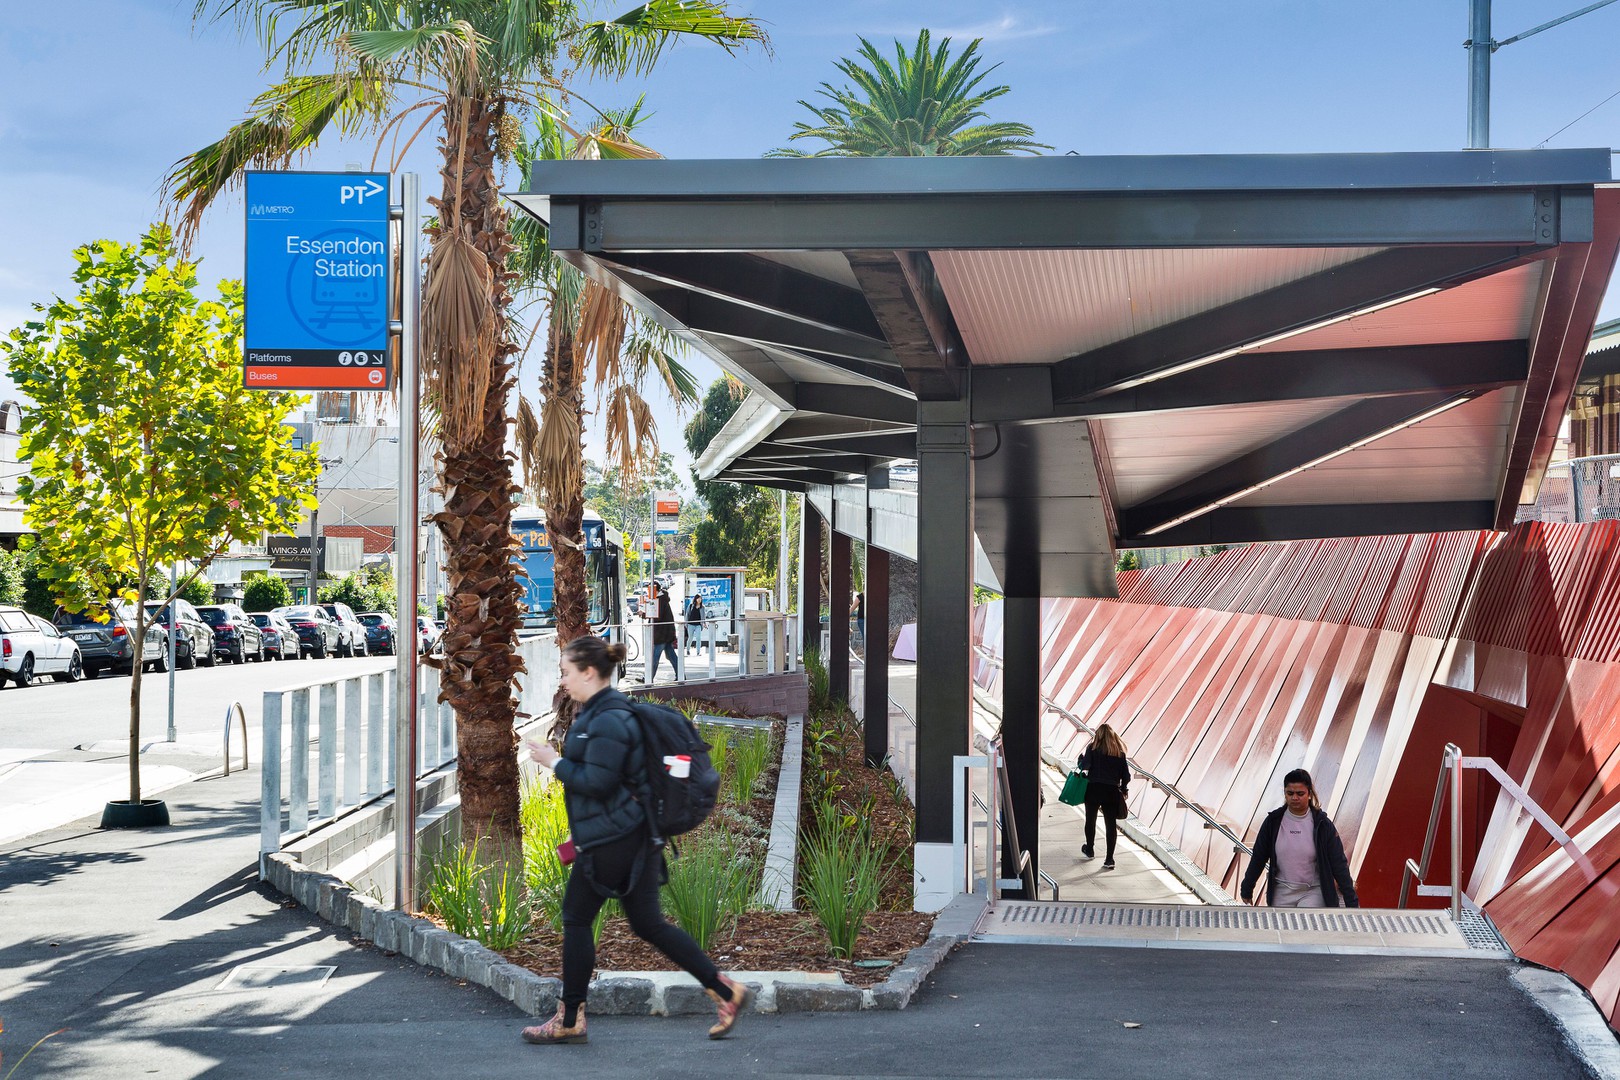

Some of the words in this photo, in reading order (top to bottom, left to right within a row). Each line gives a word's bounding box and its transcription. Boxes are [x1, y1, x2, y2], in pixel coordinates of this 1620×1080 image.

[265, 205, 295, 214] METRO
[286, 235, 384, 255] Essendon
[314, 258, 384, 277] Station
[249, 353, 292, 363] Platforms
[249, 371, 278, 381] Buses
[530, 530, 550, 547] Par
